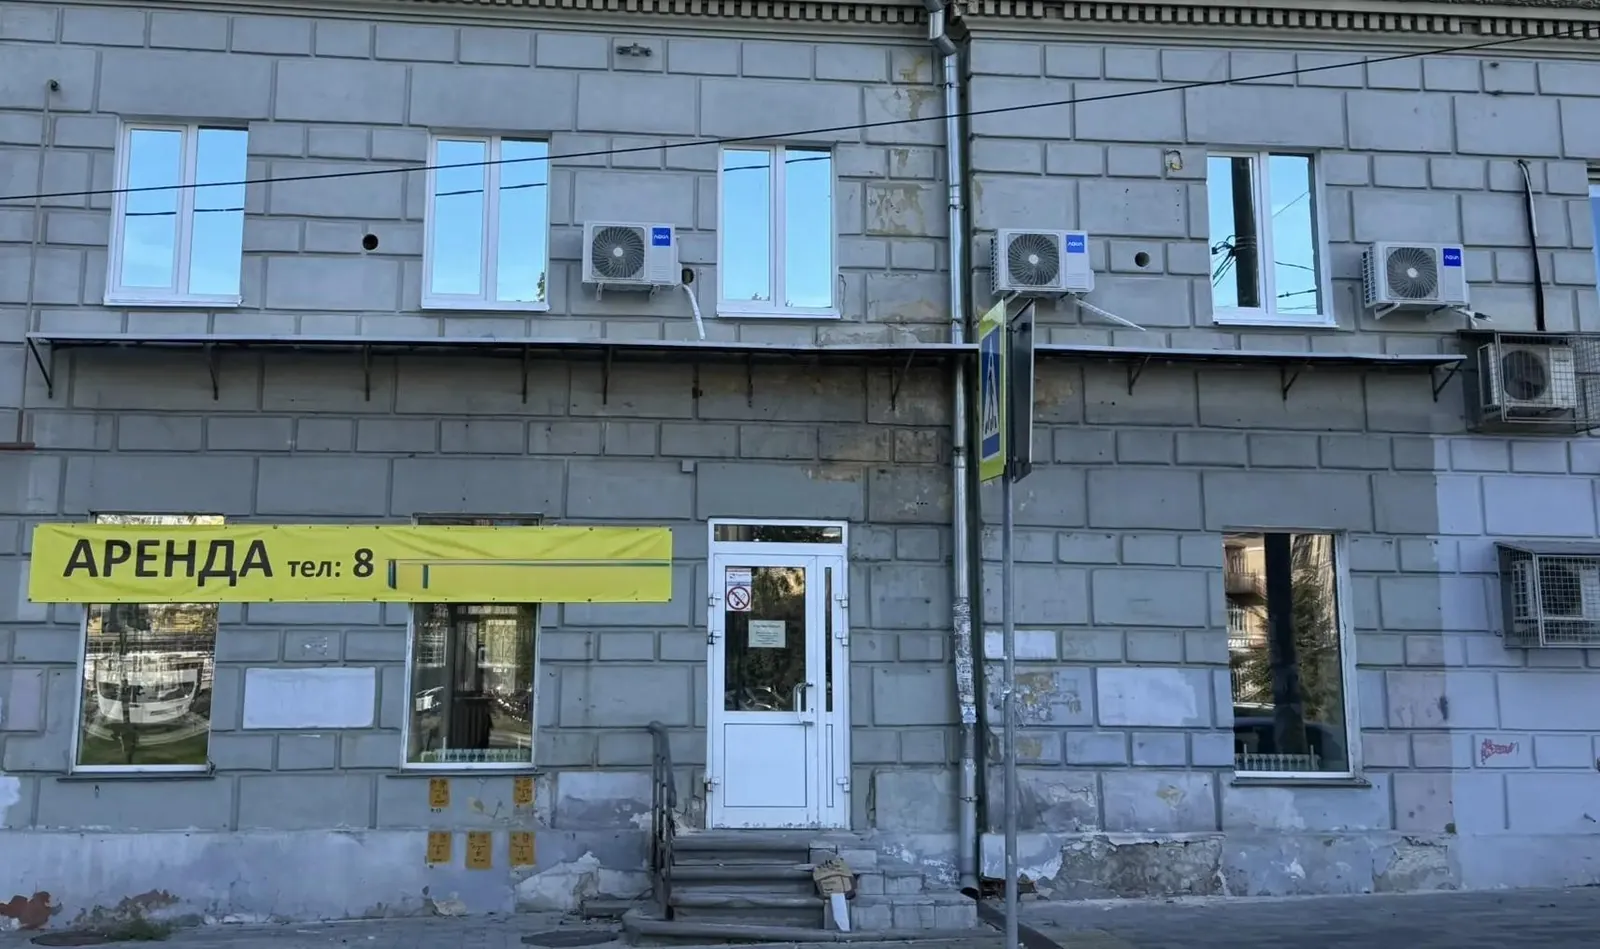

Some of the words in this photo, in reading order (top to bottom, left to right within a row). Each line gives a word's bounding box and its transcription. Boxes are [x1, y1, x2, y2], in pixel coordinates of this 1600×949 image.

[63, 539, 274, 587] АРЕНДА
[287, 560, 341, 578] тел:
[353, 548, 374, 578] 8
